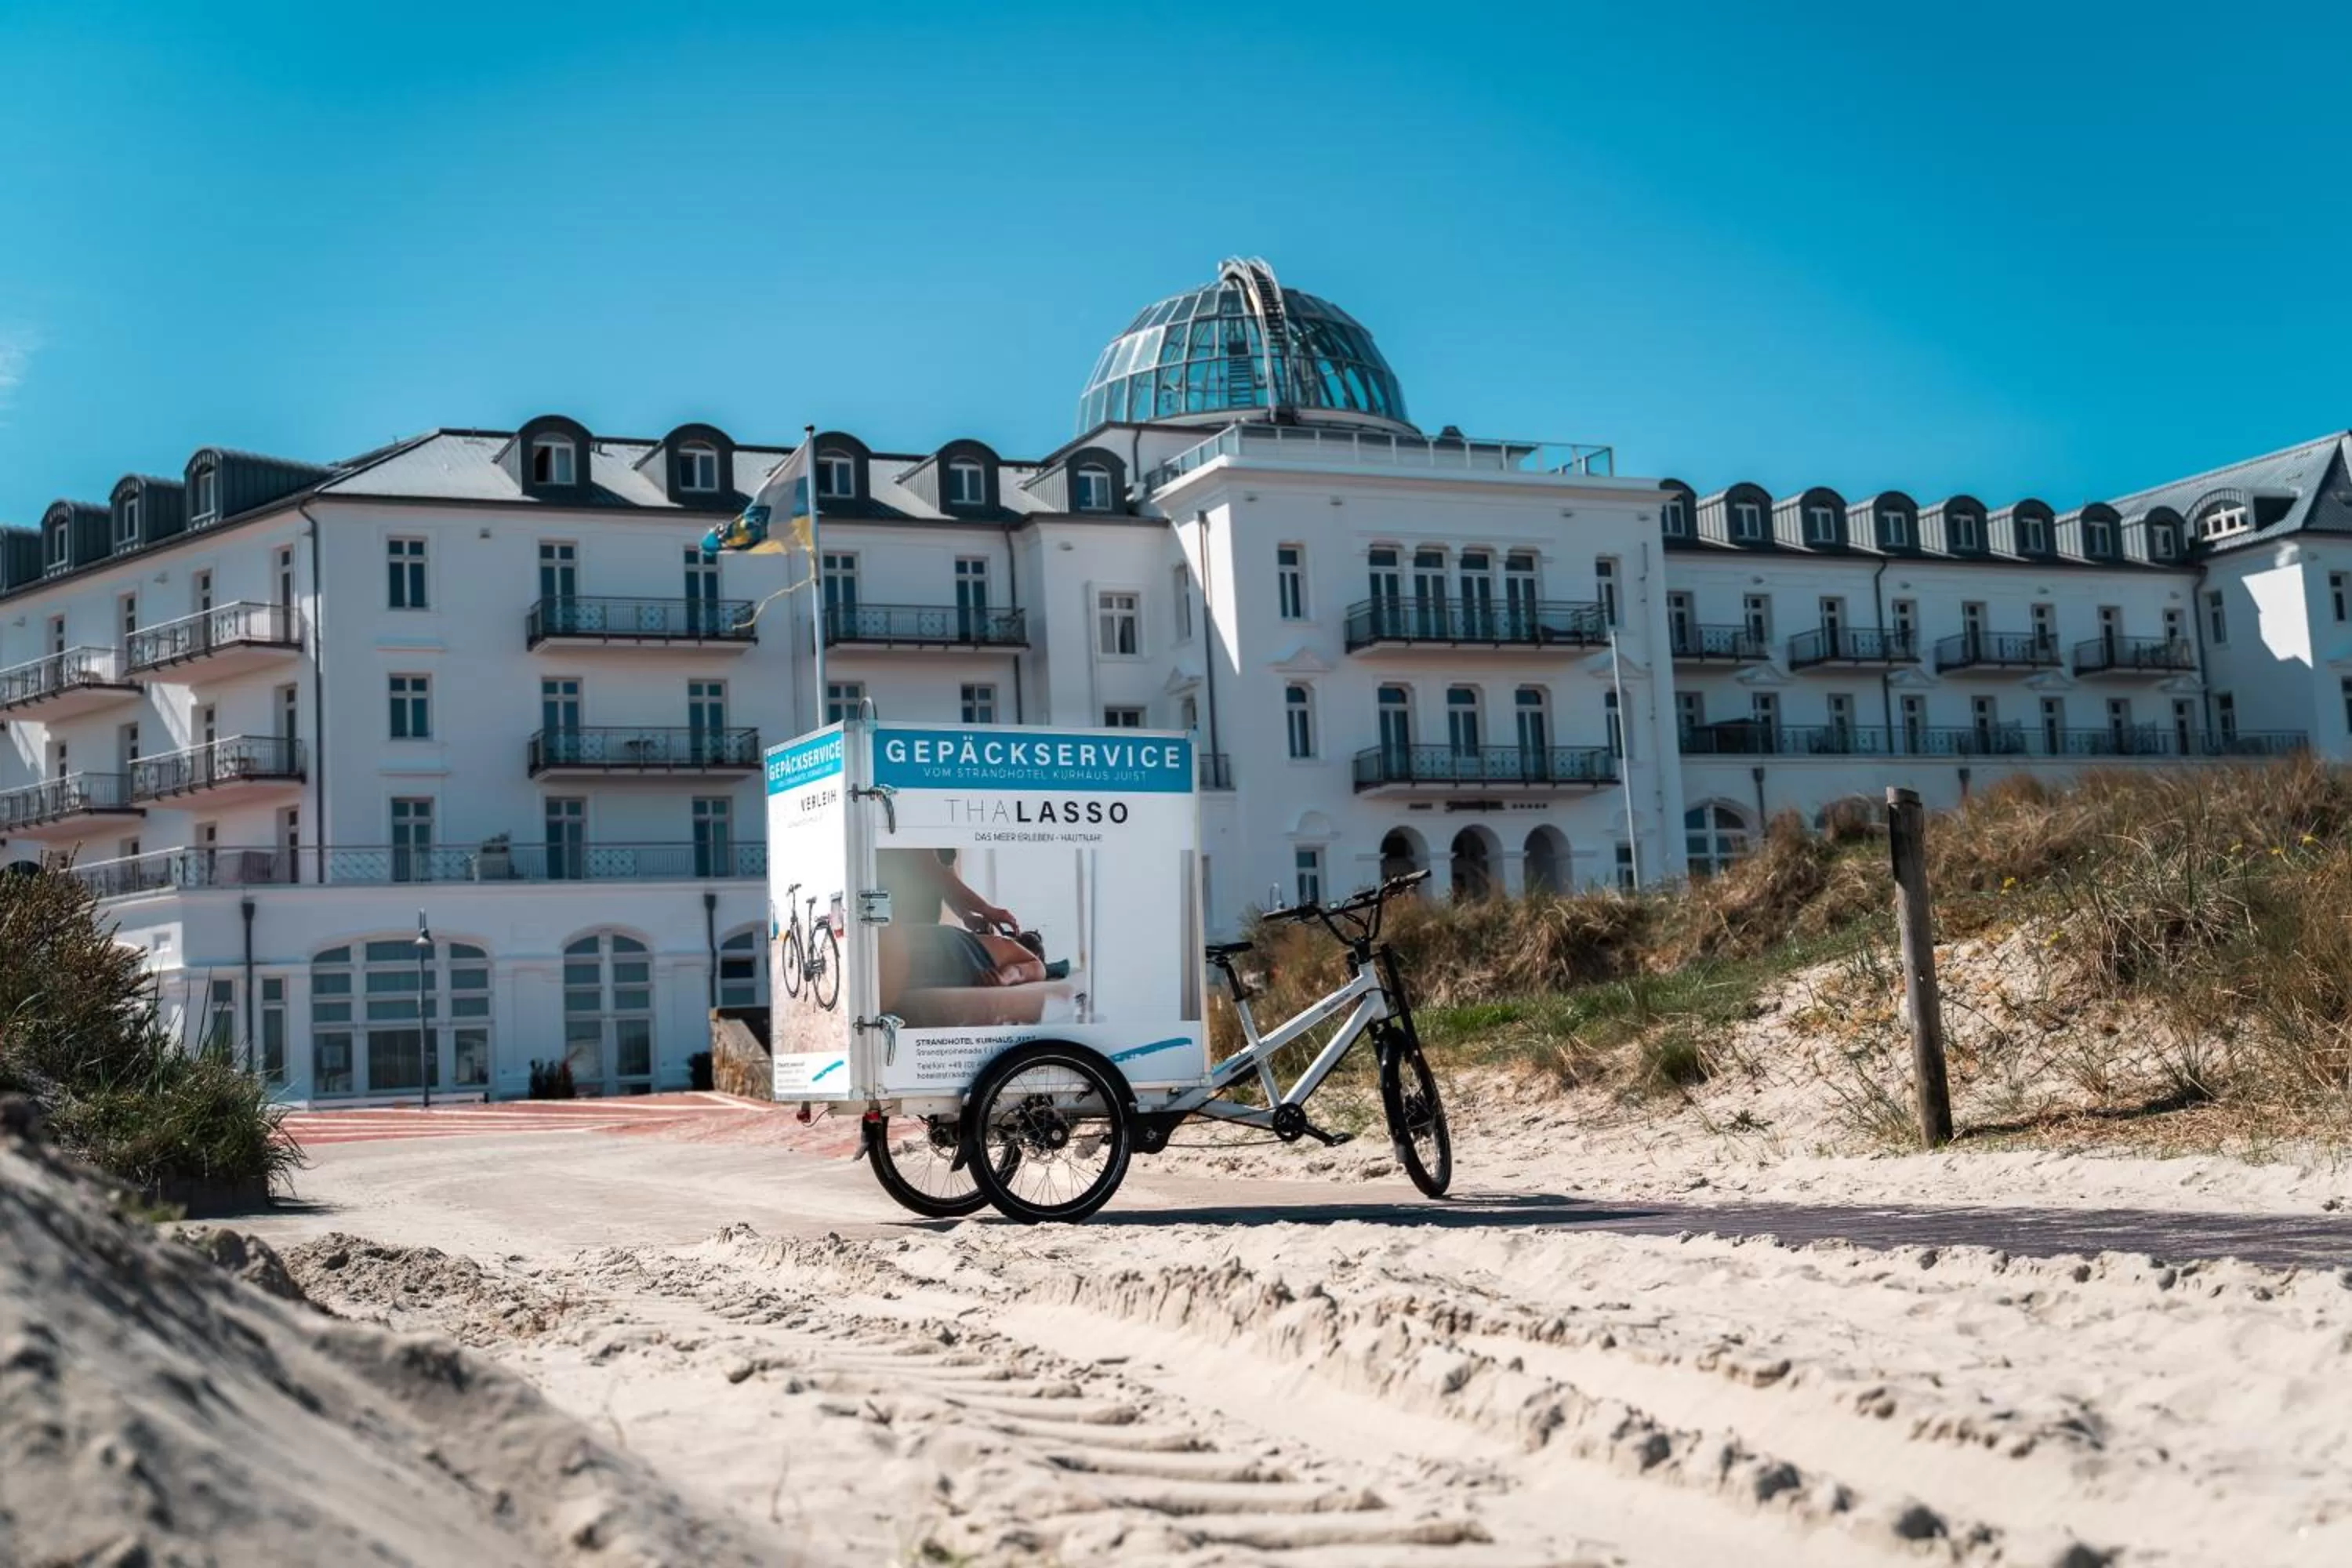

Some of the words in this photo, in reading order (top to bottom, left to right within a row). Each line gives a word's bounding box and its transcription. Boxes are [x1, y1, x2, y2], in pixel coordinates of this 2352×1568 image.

[769, 740, 841, 782] GEPÄCKSERVICE
[885, 735, 1180, 768] GEPÄCKSERVICE
[924, 767, 952, 778] VOM
[957, 768, 1047, 780] STRANDHOTEL
[1053, 769, 1109, 781] KURHAUS
[1113, 770, 1147, 782] JUIST
[800, 789, 837, 811] VERLEIH
[943, 798, 1129, 824] THALASSO
[975, 832, 992, 841] DAS
[993, 832, 1017, 841] MEER
[915, 1037, 974, 1046] STRANDHOTEL
